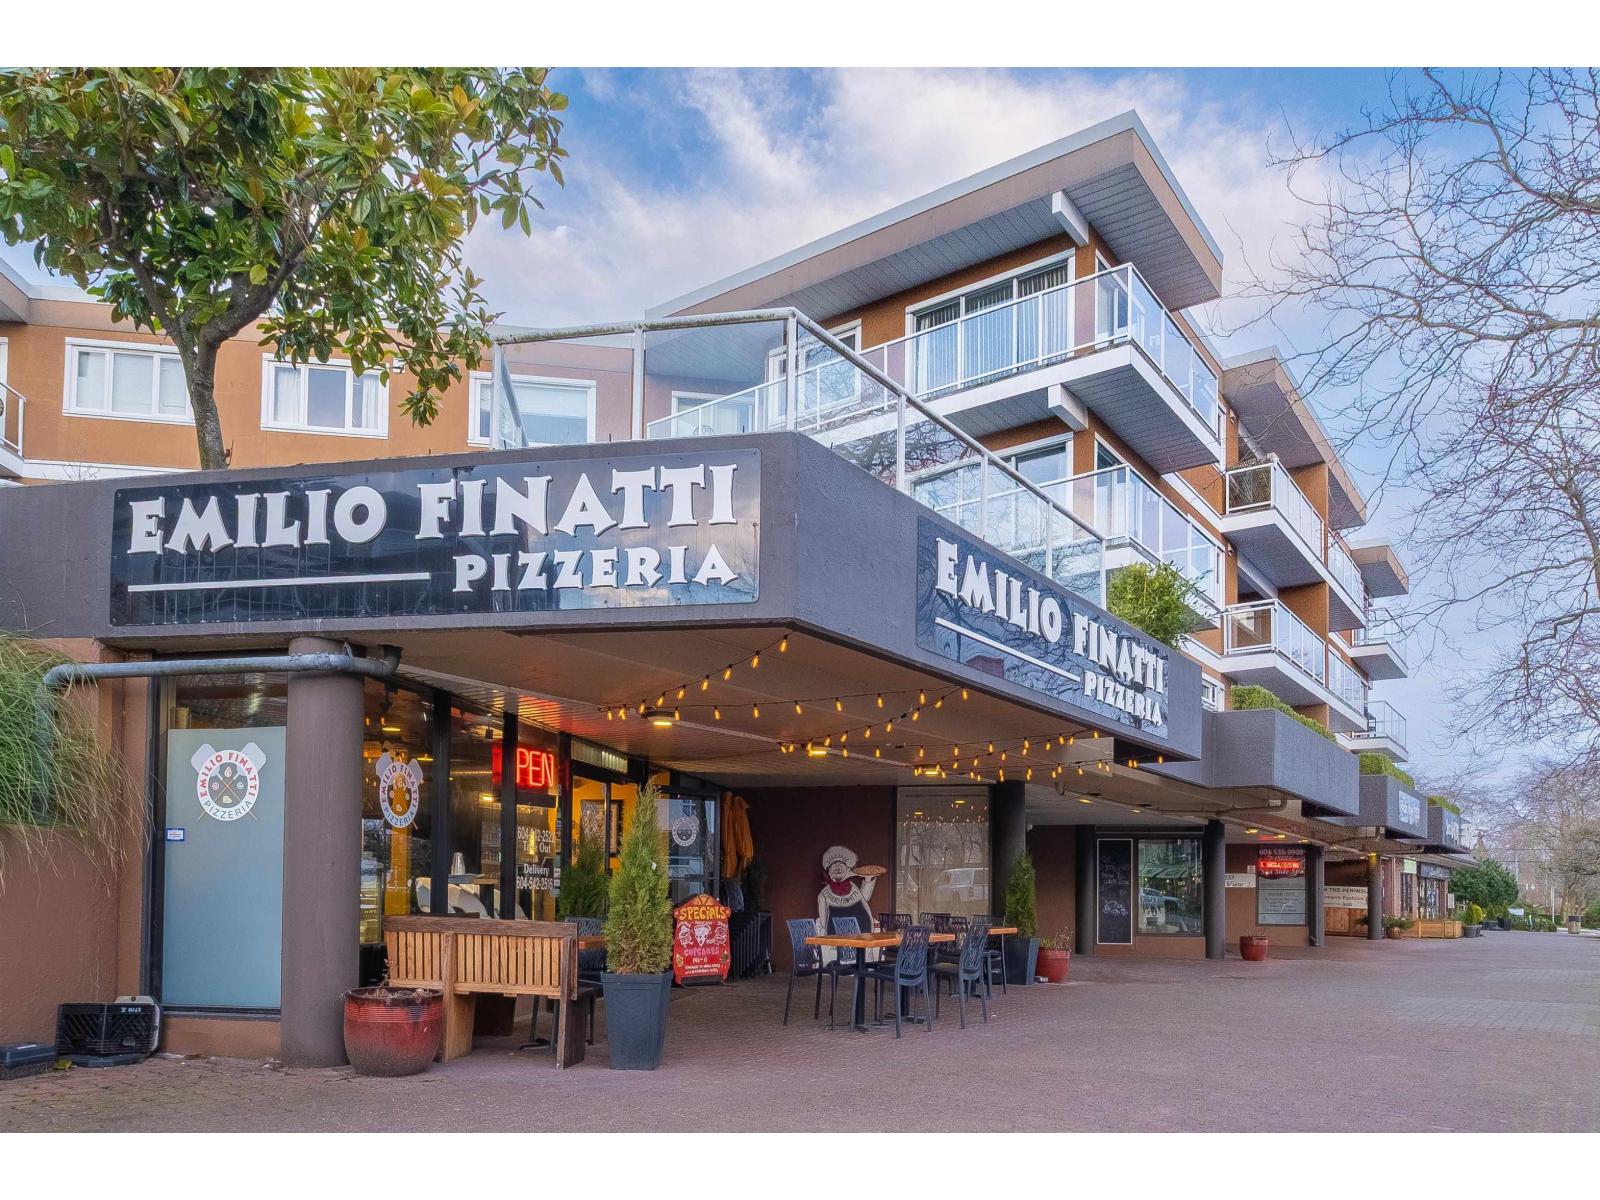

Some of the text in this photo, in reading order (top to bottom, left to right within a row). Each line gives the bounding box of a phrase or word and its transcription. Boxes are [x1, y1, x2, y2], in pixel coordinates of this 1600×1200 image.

[126, 463, 738, 555] EMILIO FINATTI
[452, 543, 739, 593] PIZZERIA
[935, 538, 1165, 694] EMILIO FINATTI
[1083, 670, 1163, 727] PIZZERIA
[200, 752, 257, 798] EMILIO FINATTI
[381, 765, 418, 808] EMILIO FINATTI
[516, 748, 554, 787] PEN
[203, 800, 253, 819] PIZZERIA
[522, 841, 551, 853] Tae Out
[523, 863, 549, 877] Delivery
